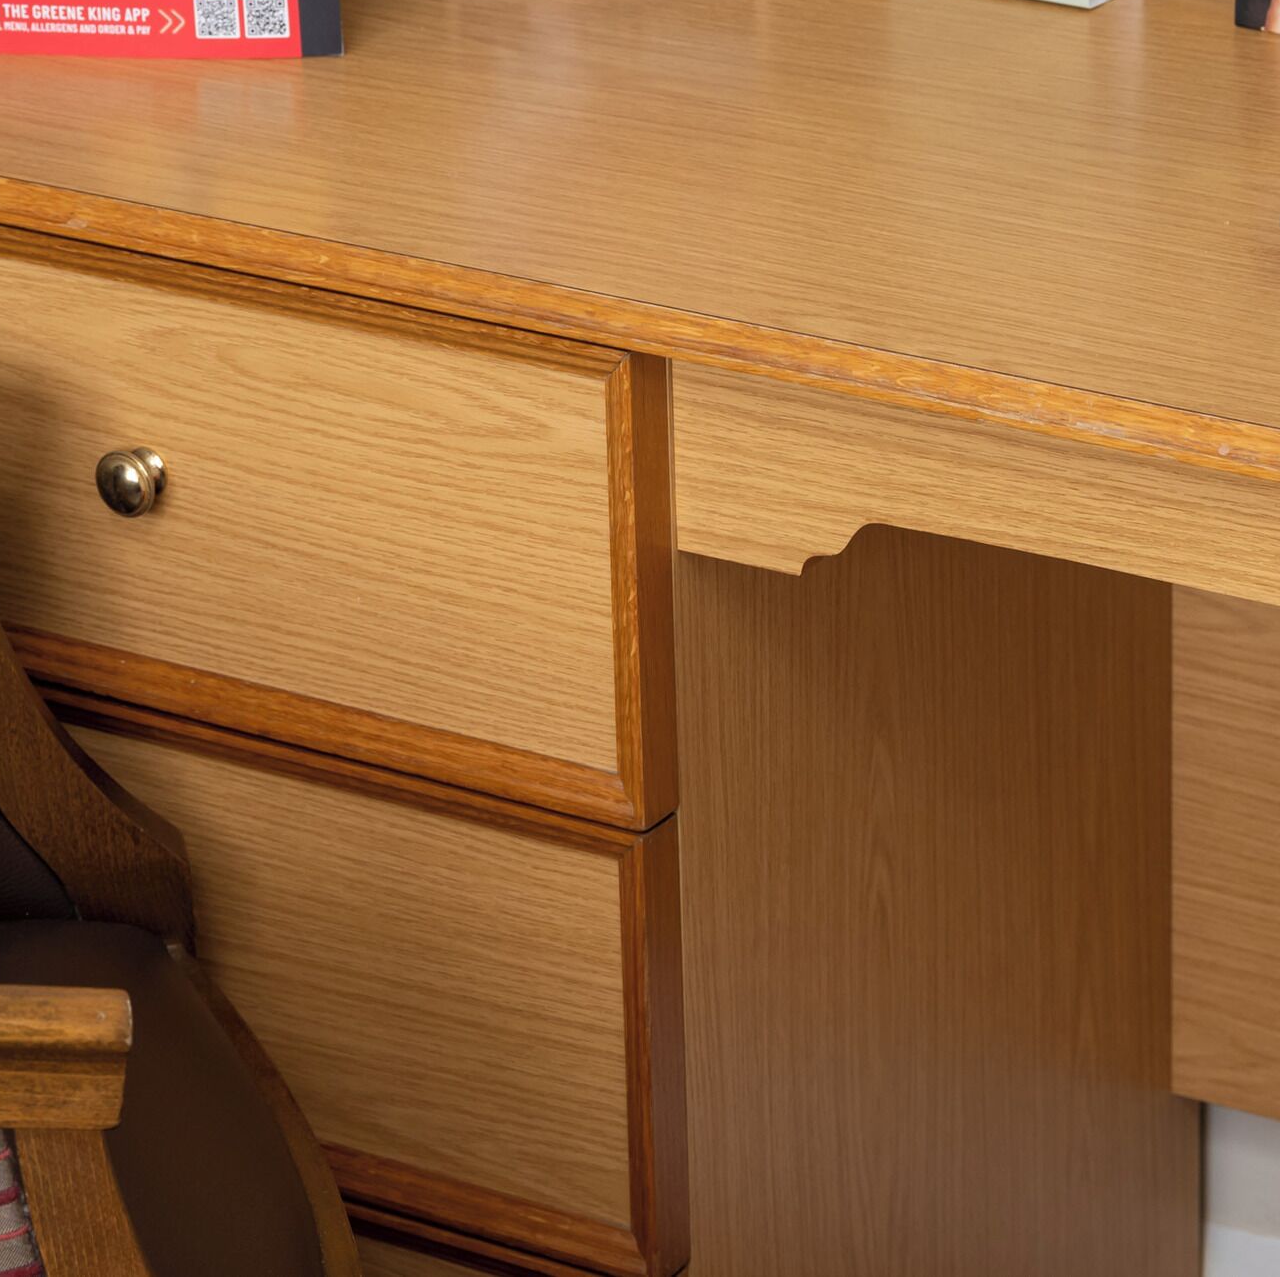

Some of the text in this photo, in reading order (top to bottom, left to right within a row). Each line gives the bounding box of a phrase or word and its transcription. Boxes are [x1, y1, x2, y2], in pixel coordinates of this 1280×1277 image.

[2, 3, 30, 19] THE
[32, 4, 85, 21] GREENE
[87, 6, 121, 22] KING
[124, 7, 151, 22] APP
[31, 22, 78, 33] ALLERGENS
[80, 24, 96, 34] AND
[98, 25, 126, 35] ORDER
[136, 25, 151, 35] PAY
